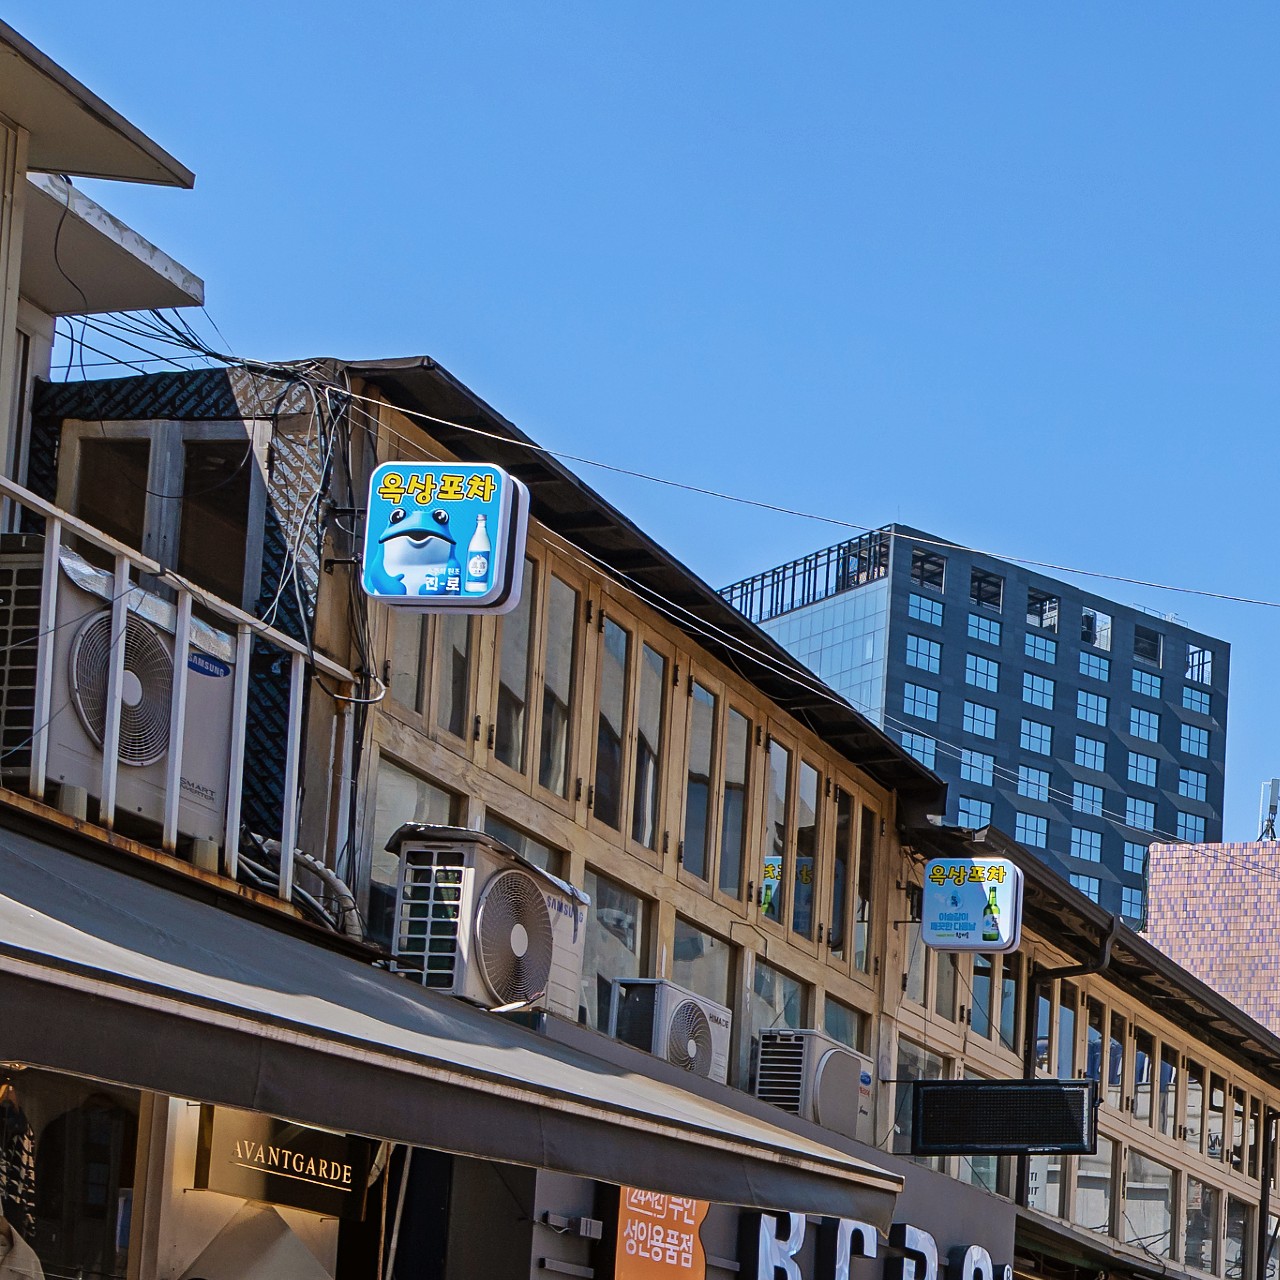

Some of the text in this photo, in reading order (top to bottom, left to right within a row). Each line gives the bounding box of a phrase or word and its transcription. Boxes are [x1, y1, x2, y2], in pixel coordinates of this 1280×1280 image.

[378, 474, 495, 504] 옥상포차
[188, 654, 225, 677] SAMSUNG
[929, 865, 1006, 886] 옥상포차
[232, 1139, 353, 1185] AVANTGARDE
[623, 1219, 694, 1268] 성인용품점
